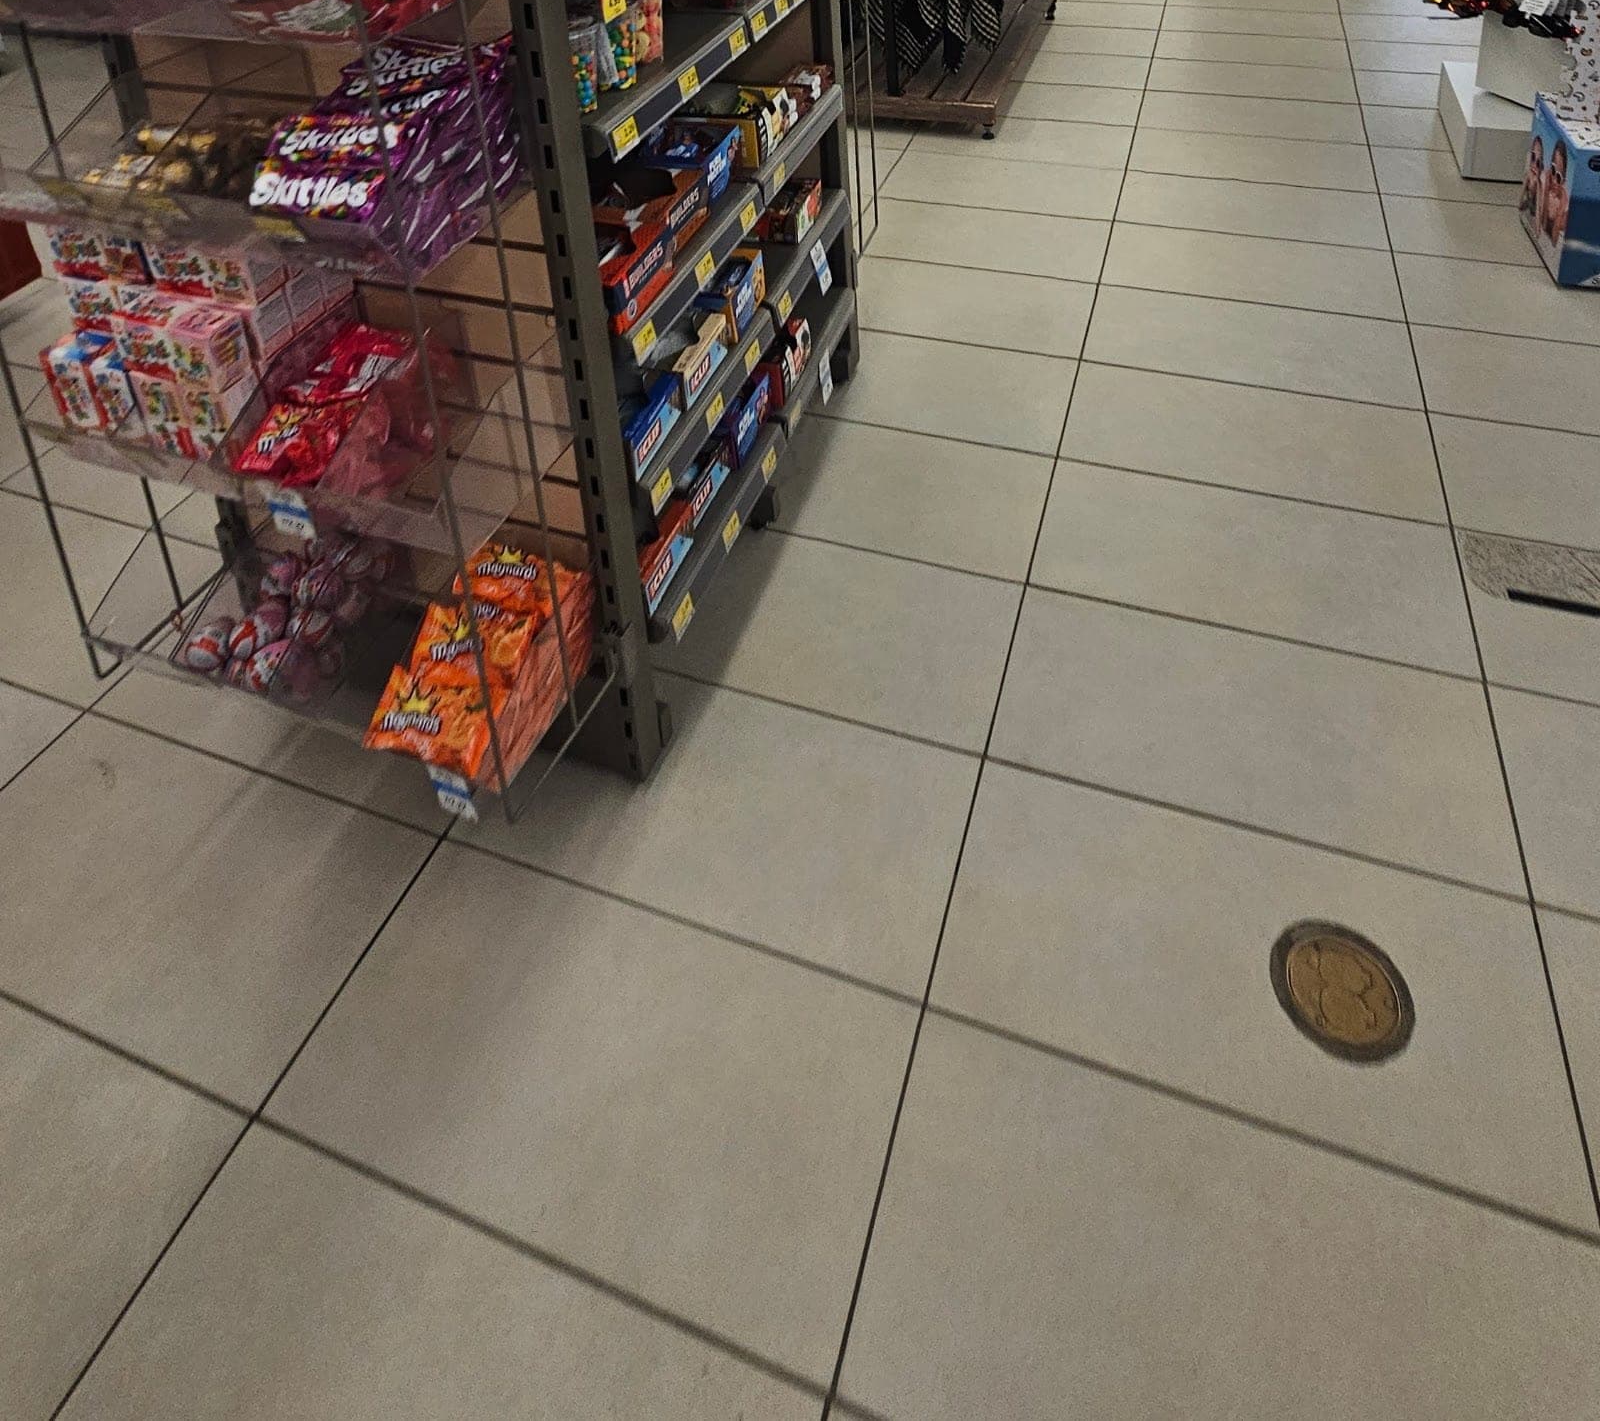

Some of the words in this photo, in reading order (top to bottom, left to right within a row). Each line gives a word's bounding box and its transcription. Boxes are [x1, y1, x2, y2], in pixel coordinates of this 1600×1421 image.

[249, 172, 369, 208] Skittles
[476, 560, 538, 580] Maynards
[379, 711, 442, 735] Maynards
